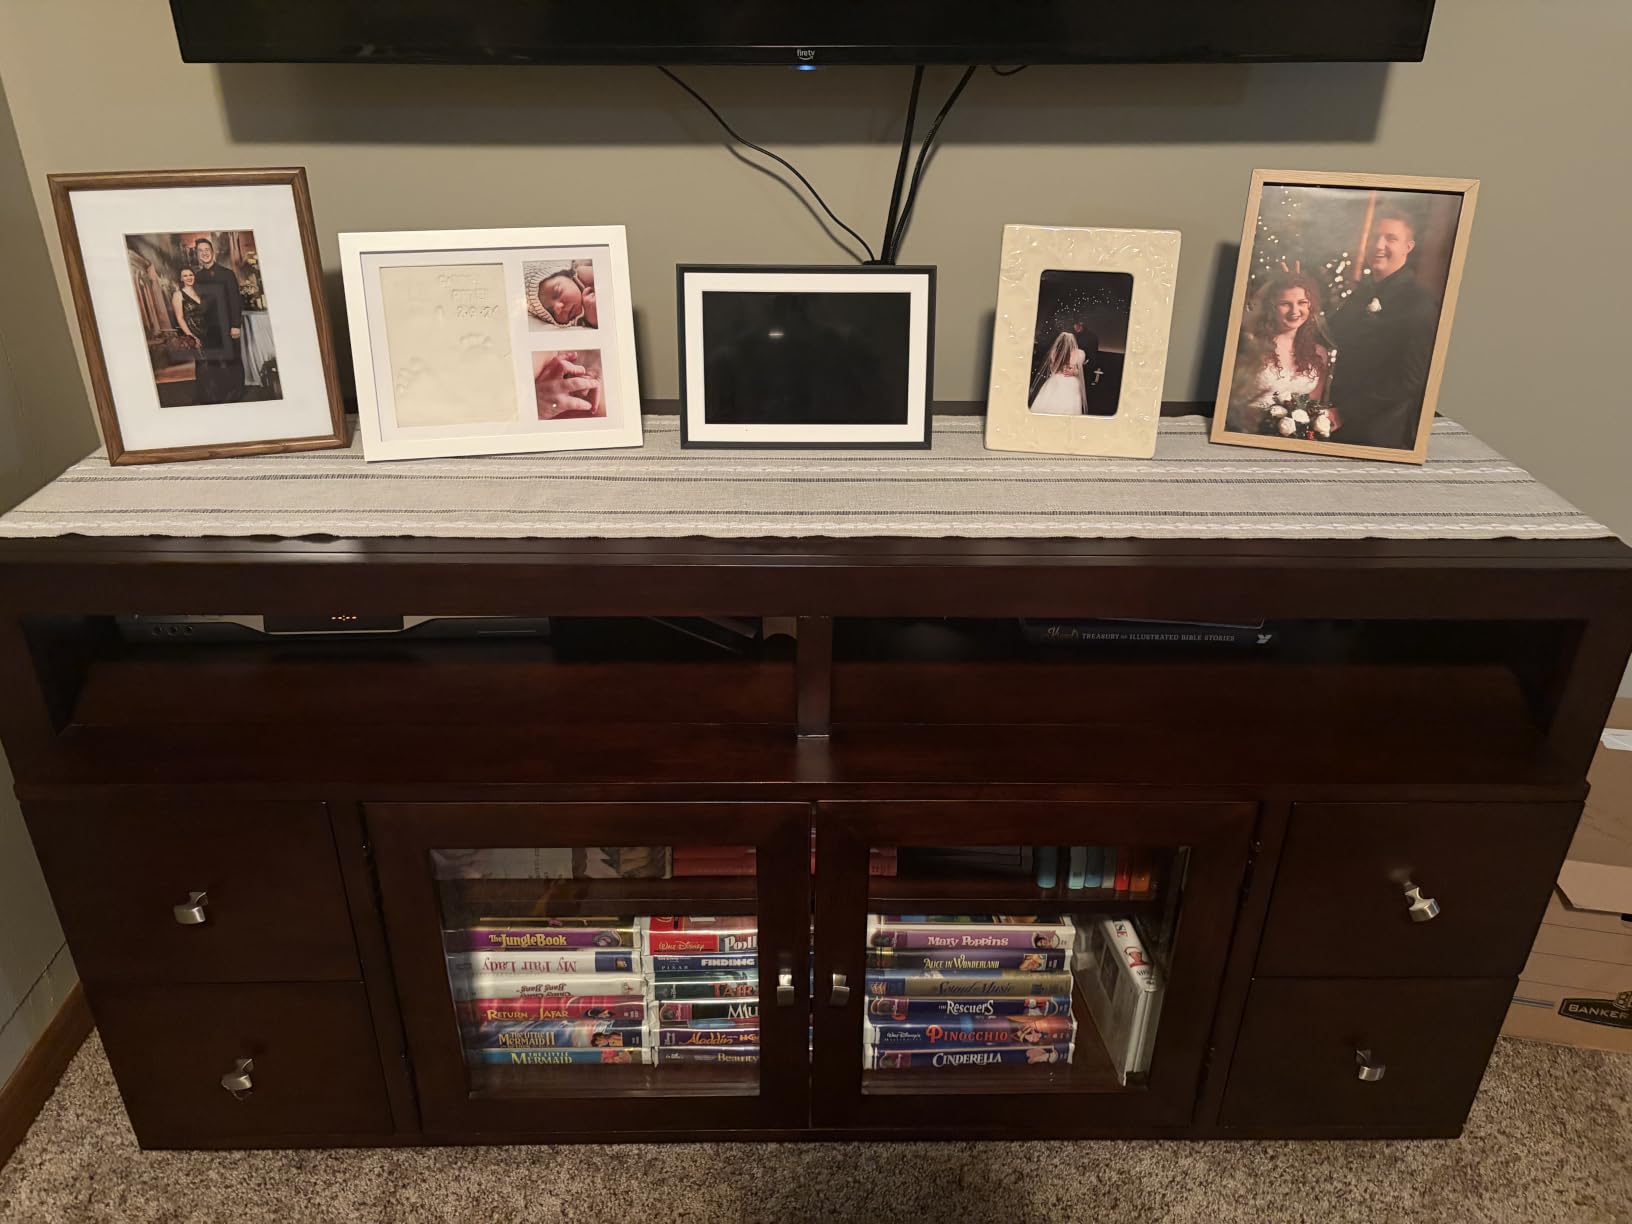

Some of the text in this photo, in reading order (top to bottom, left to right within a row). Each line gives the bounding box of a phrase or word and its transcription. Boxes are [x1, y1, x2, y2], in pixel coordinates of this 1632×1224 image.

[1129, 633, 1179, 641] ILLUSTRATED
[1205, 634, 1235, 642] STORIES
[928, 935, 1009, 947] Mary Poppins
[482, 957, 516, 973] Lady
[557, 957, 577, 972] My
[953, 954, 999, 969] WONDERLAND
[687, 1032, 733, 1045] Aladdin
[926, 1024, 1008, 1044] PINOCCHIO
[932, 1053, 1002, 1068] CINDERELLA
